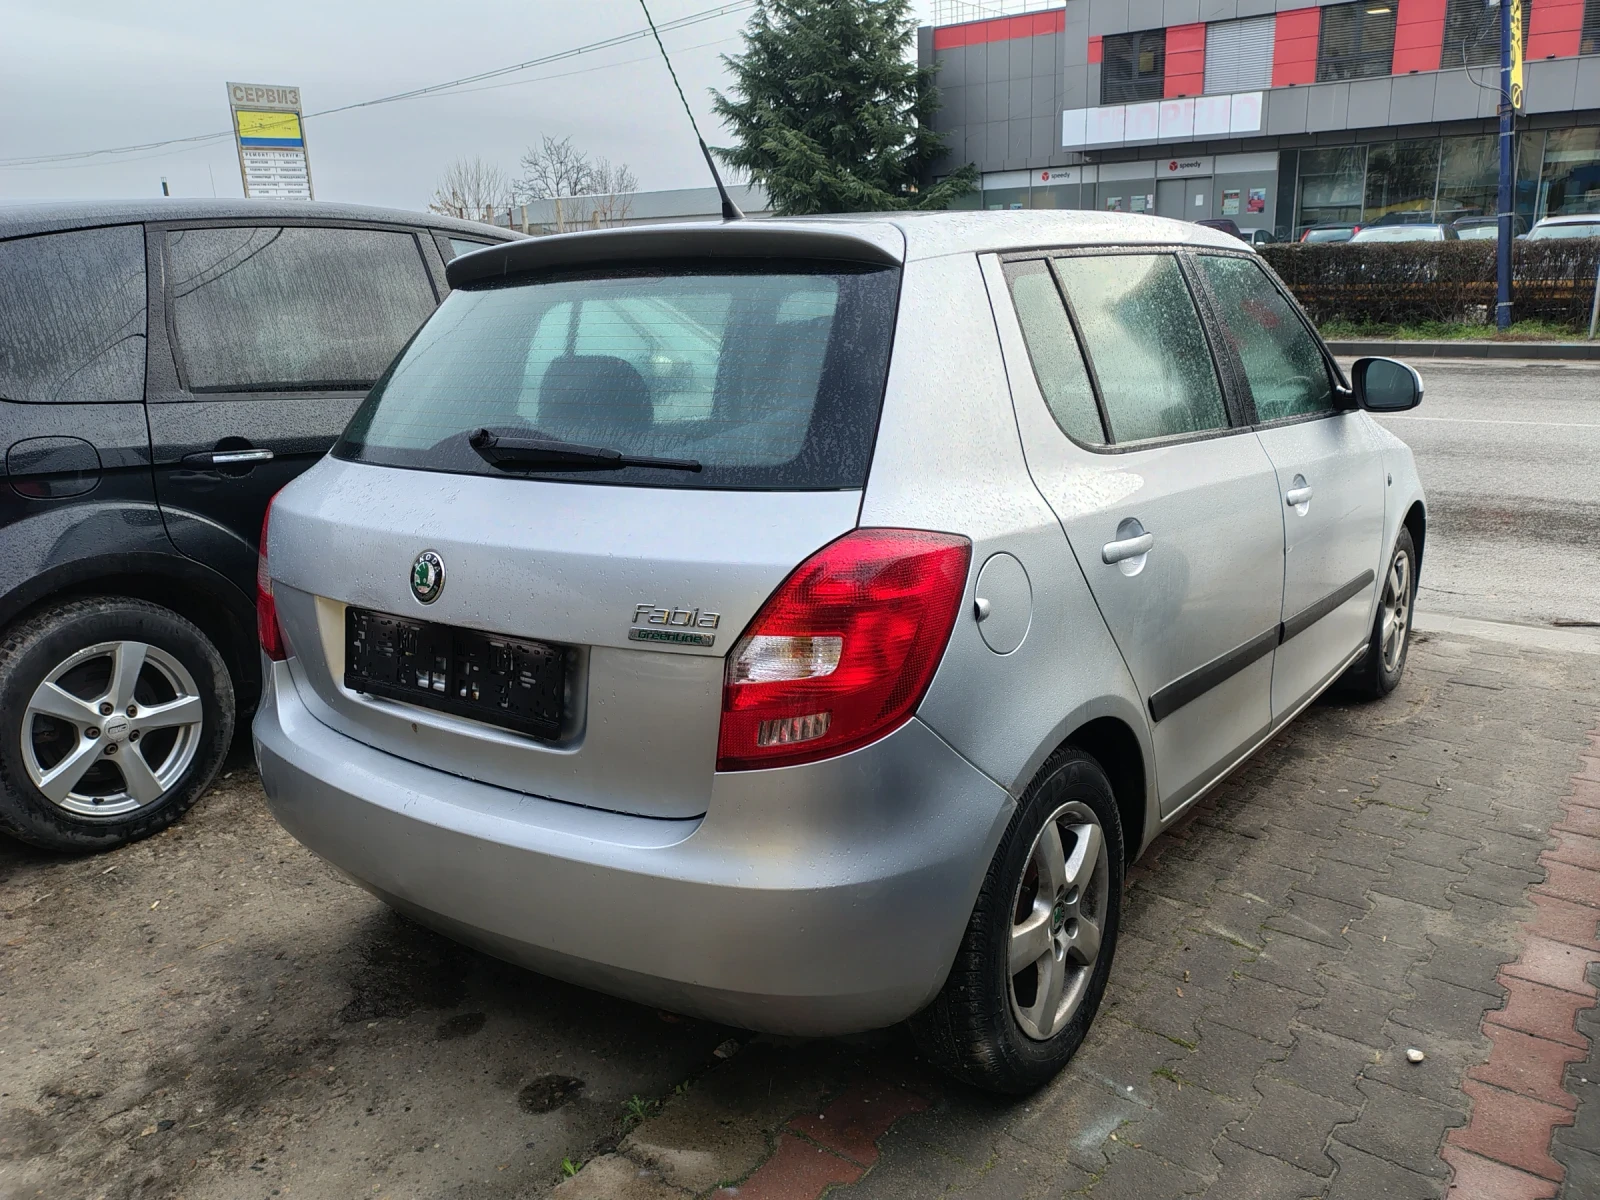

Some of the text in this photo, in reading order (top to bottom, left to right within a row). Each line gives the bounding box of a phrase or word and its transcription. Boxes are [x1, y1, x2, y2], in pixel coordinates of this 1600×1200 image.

[233, 86, 299, 105] СЕРВИЗ
[1179, 160, 1202, 169] speedy
[1051, 171, 1071, 179] speedy
[632, 603, 720, 629] Fabia
